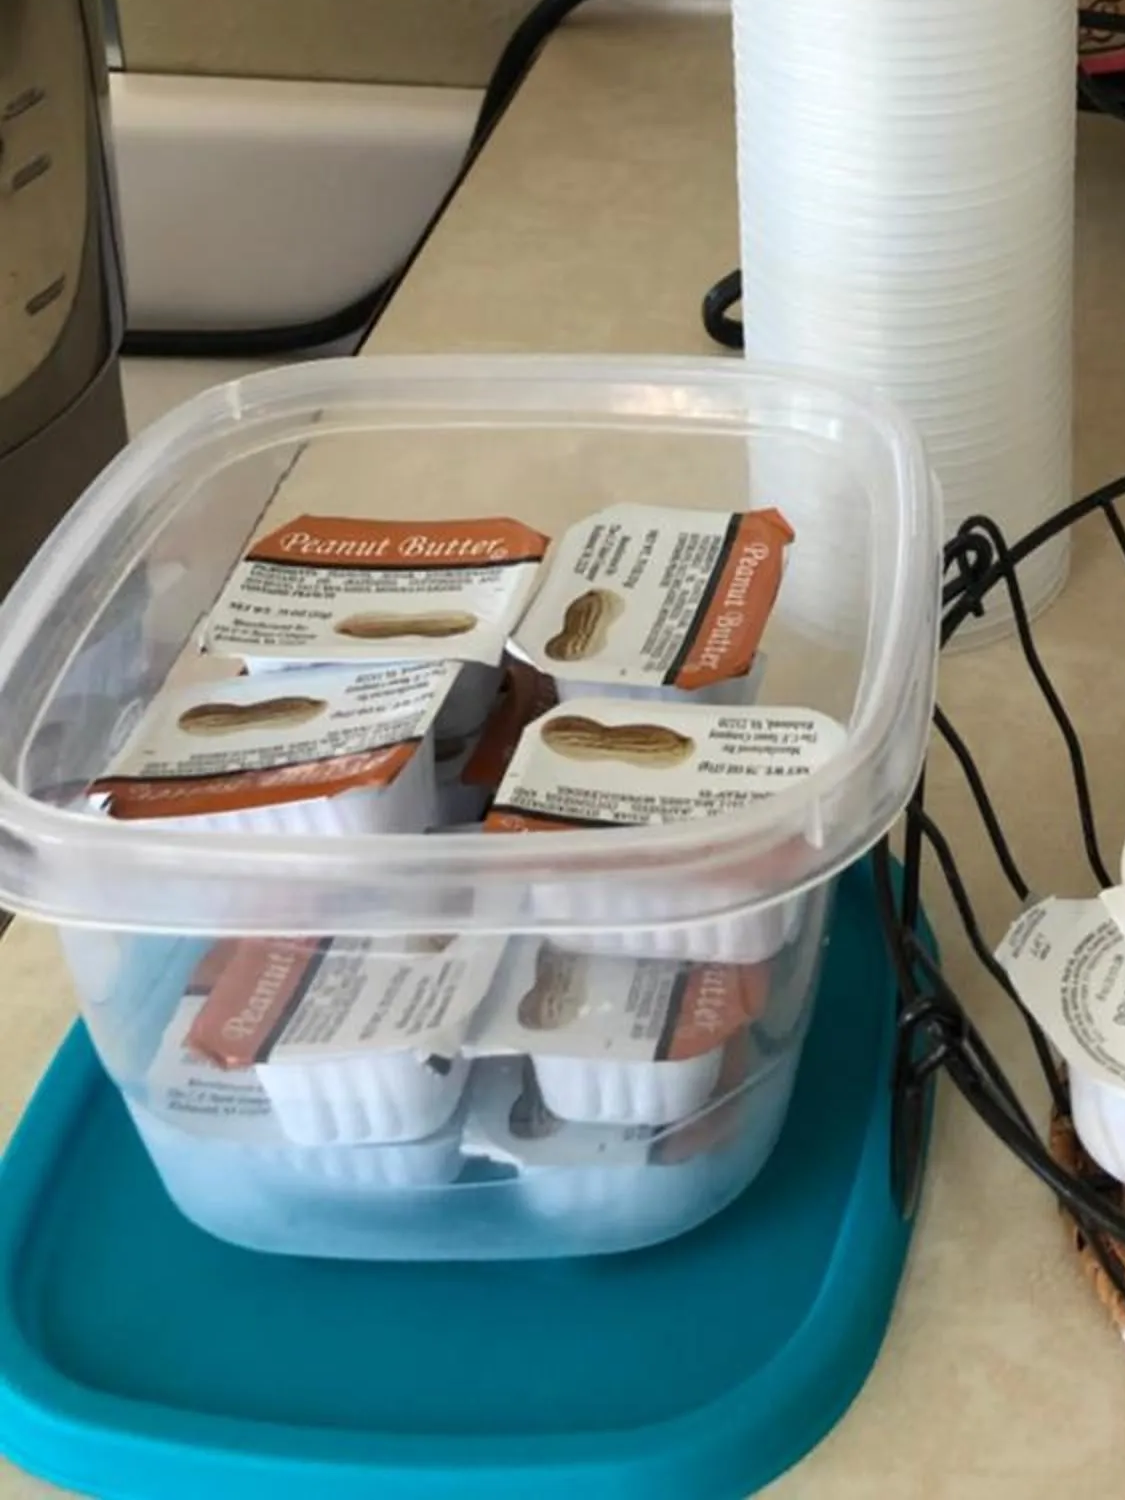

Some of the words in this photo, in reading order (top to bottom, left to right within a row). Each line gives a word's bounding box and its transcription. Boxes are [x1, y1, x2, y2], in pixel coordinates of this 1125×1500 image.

[279, 532, 392, 558] Peanut
[397, 534, 504, 558] Butter
[725, 542, 769, 607] Peanut
[700, 611, 743, 670] Butter
[220, 951, 297, 1040] Peanut
